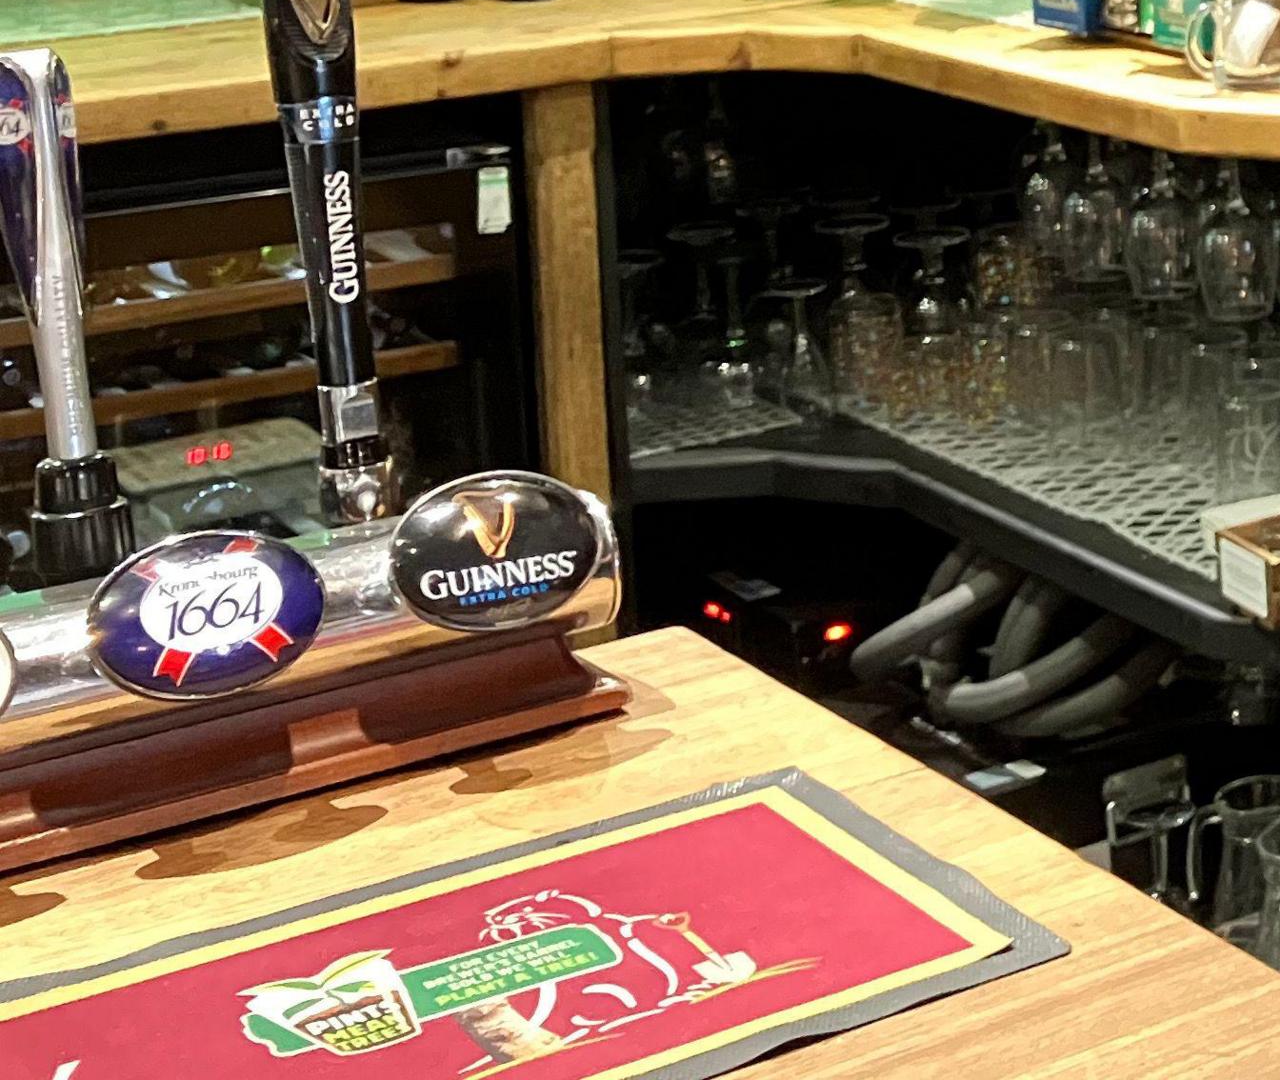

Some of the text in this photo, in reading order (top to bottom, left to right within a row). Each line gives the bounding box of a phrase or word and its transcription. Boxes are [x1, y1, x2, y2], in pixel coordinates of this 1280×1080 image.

[323, 170, 360, 304] GUINNESS
[420, 550, 577, 601] GUINNESS
[459, 581, 549, 607] EXTRA COLD
[165, 581, 265, 641] 1664
[434, 978, 507, 1006] PLANT
[514, 972, 533, 983] A
